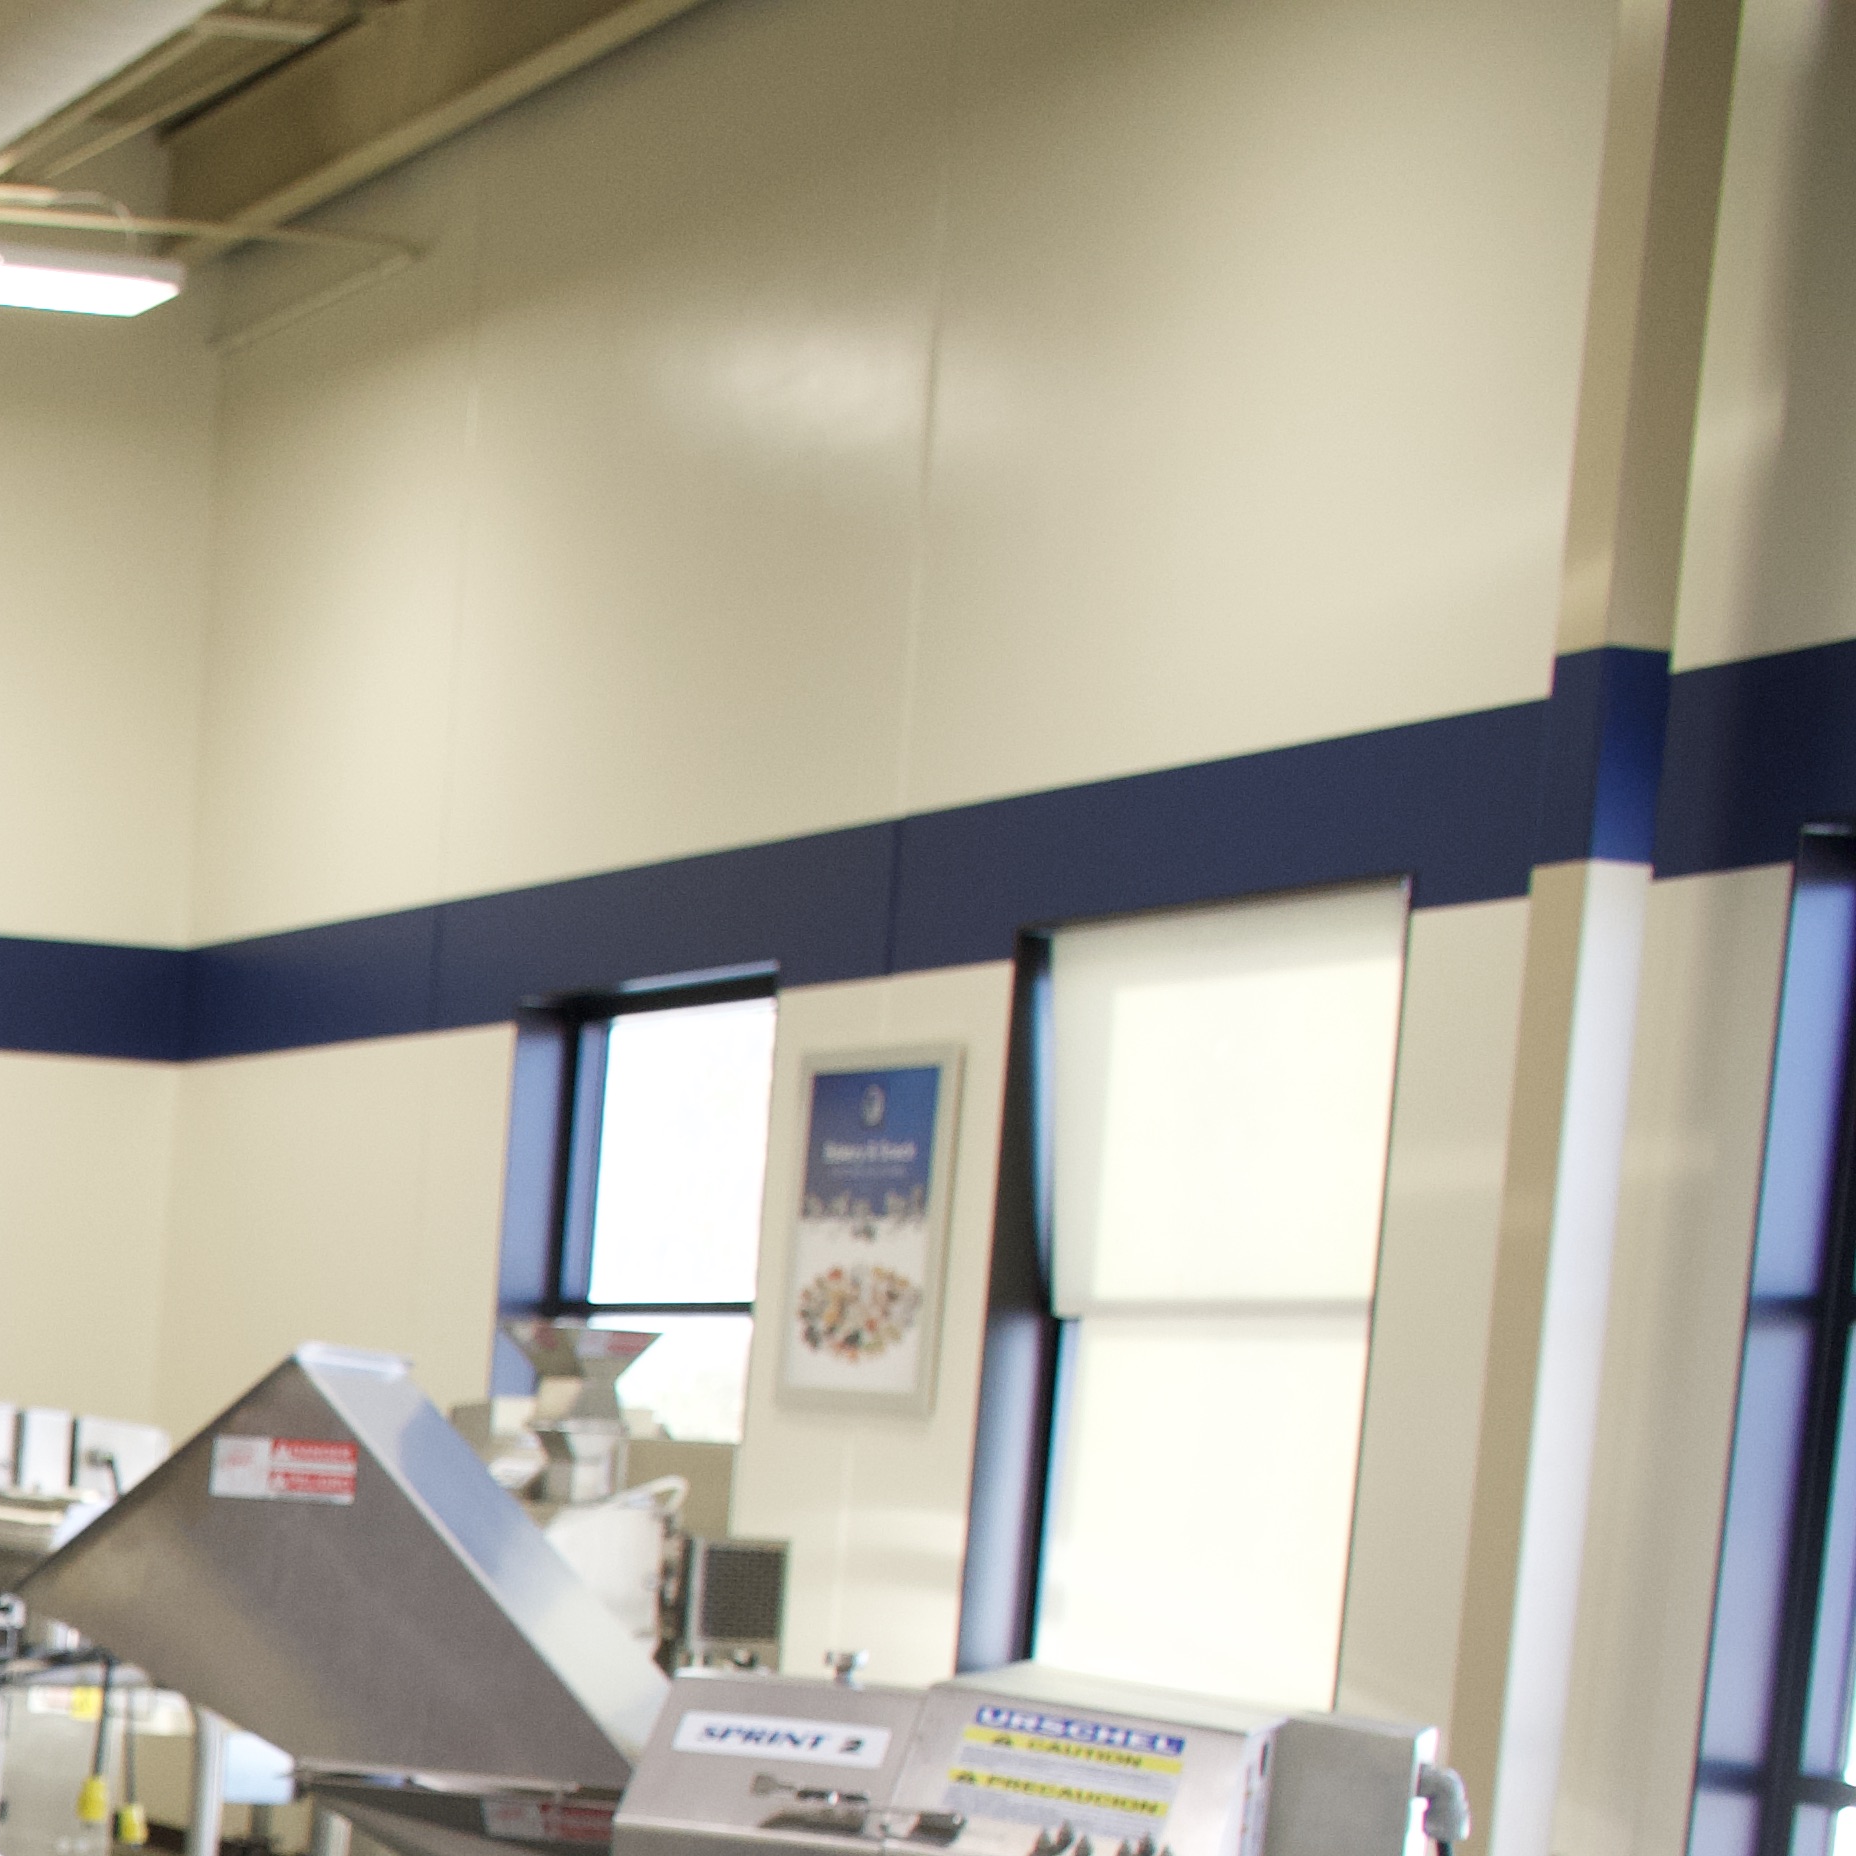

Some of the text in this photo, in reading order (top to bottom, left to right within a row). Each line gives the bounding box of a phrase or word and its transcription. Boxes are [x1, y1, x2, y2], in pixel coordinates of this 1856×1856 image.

[697, 1725, 865, 1754] SPRINT 2
[980, 1707, 1180, 1754] URSCHEL
[1026, 1739, 1143, 1768] CAUTION
